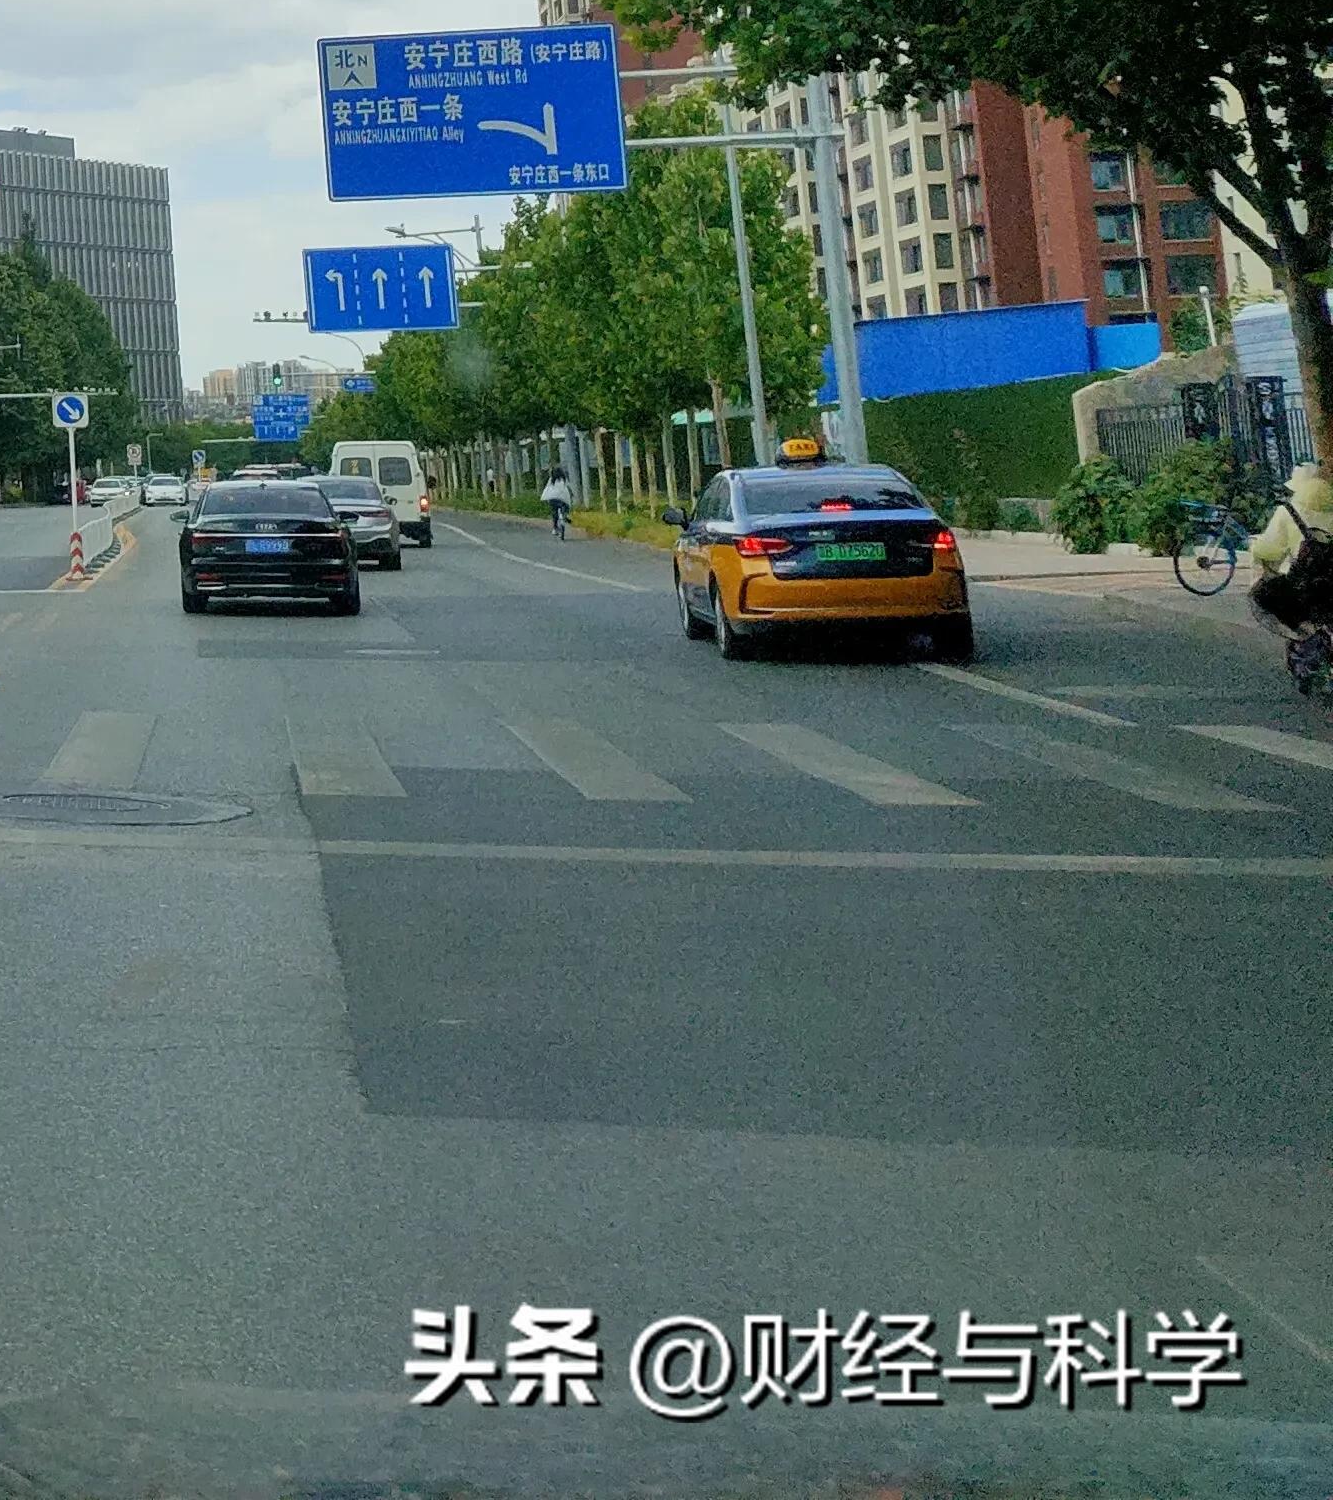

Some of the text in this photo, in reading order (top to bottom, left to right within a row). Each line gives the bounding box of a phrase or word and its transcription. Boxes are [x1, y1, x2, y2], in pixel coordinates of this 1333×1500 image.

[335, 49, 368, 68] 北 N
[404, 38, 523, 70] 安宁庄西路
[408, 68, 528, 89] ANNINGZHUANG West Rd
[332, 93, 463, 127] 安宁庄西一条
[442, 125, 464, 144] Alley
[508, 162, 610, 186] 安宁庄西一条东口
